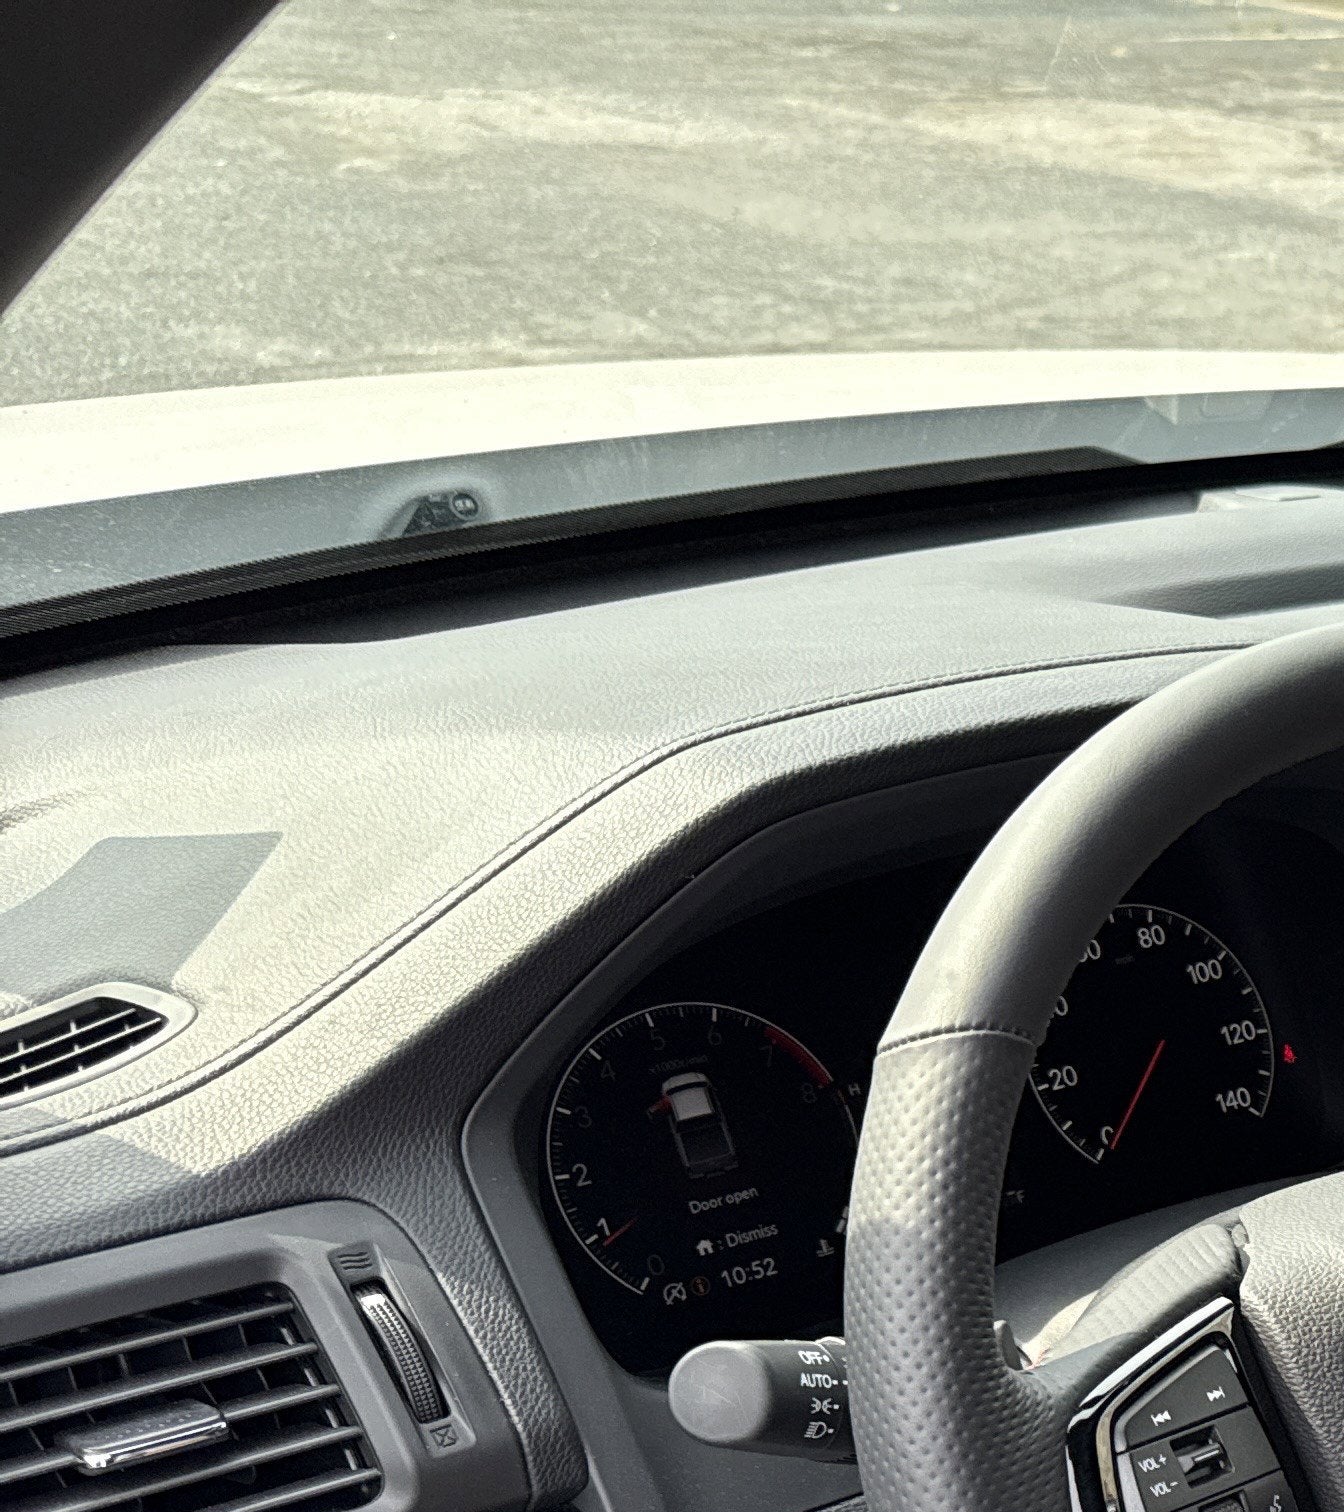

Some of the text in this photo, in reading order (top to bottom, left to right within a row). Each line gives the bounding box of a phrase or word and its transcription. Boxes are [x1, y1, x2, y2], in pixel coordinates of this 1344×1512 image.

[1137, 924, 1166, 948] 80
[1186, 959, 1223, 984] 100
[650, 1031, 666, 1051] 5
[707, 1028, 723, 1047] 6
[1220, 1020, 1256, 1045] 120
[600, 1062, 616, 1081] 4
[1048, 1065, 1078, 1091] 20
[1215, 1087, 1251, 1113] 140
[577, 1105, 593, 1129] 3
[571, 1163, 593, 1187] 2
[688, 1187, 760, 1215] Door open
[596, 1217, 611, 1237] 1
[724, 1223, 779, 1248] Dismiss
[648, 1253, 666, 1277] 0
[720, 1257, 779, 1289] 10:52
[798, 1350, 823, 1365] OFF
[800, 1372, 832, 1389] AUTO
